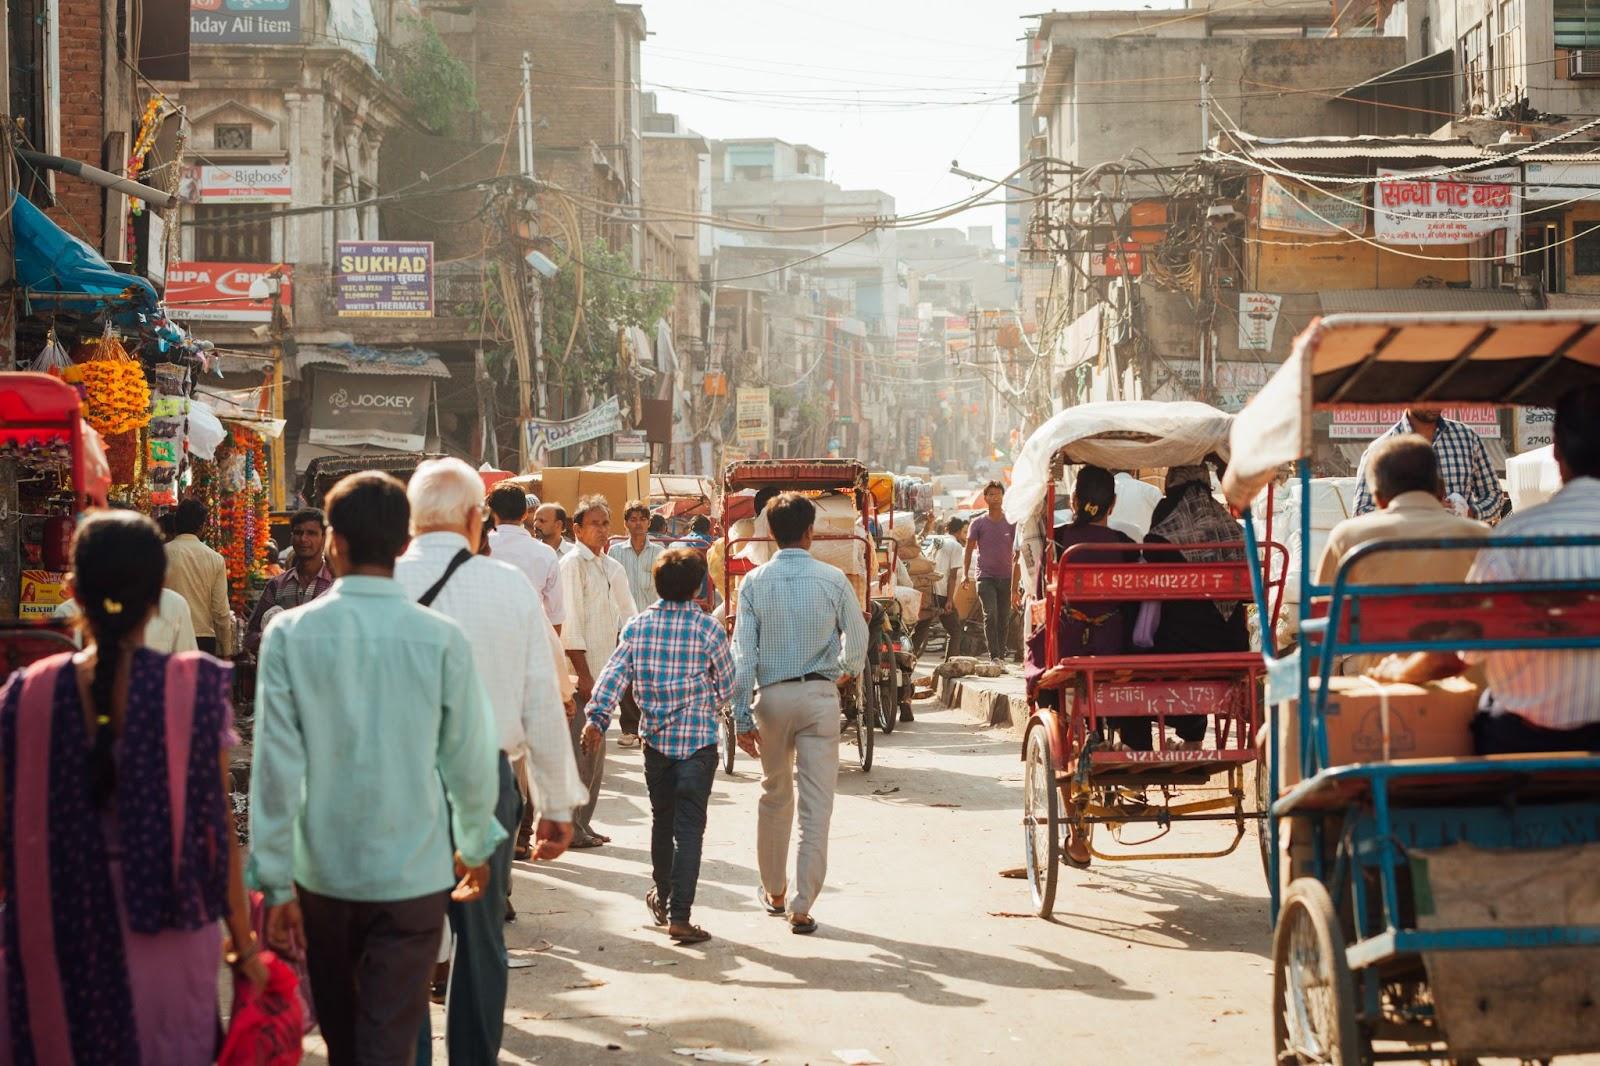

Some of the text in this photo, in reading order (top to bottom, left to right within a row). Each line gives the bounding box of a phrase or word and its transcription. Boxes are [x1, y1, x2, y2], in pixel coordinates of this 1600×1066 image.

[258, 17, 291, 32] Item
[235, 169, 283, 186] Bigboss
[341, 255, 426, 273] SUKHAD
[376, 302, 425, 310] THERMAL'S
[351, 394, 415, 408] JOCKEY
[1334, 408, 1376, 422] RAJAN
[1460, 407, 1496, 422] WALA
[1357, 426, 1371, 434] MAIN
[1093, 573, 1223, 588] K 9213402221 T
[1147, 699, 1159, 713] K
[1166, 699, 1177, 713] T
